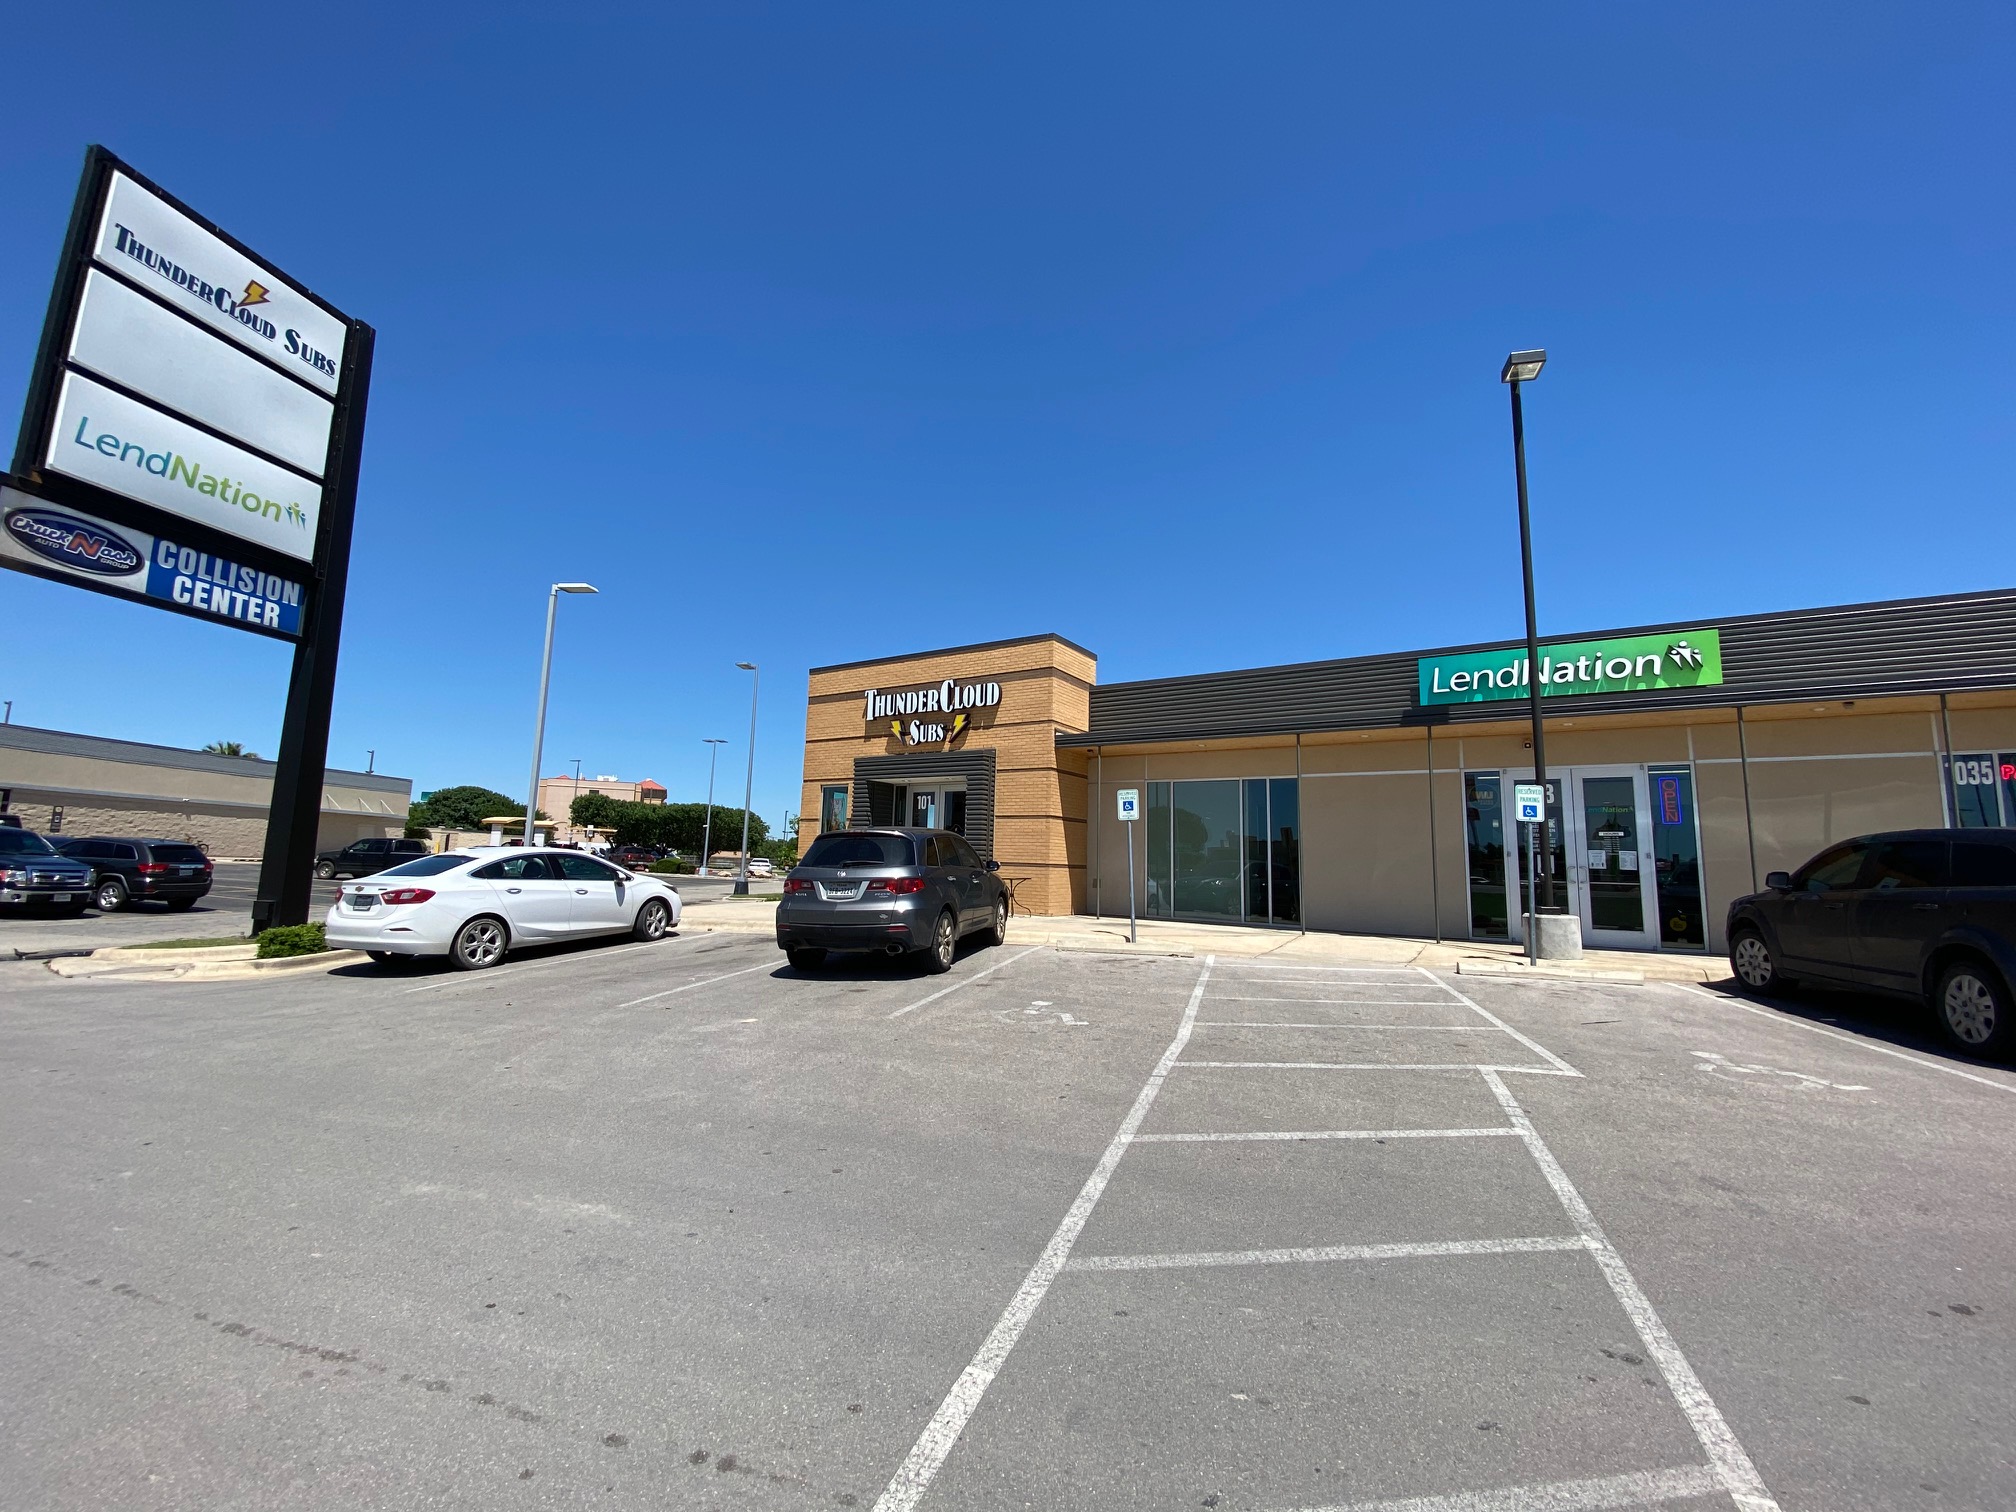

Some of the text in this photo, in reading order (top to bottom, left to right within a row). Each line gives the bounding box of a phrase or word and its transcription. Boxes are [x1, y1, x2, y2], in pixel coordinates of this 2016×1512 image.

[284, 329, 336, 376] SUBS
[74, 416, 282, 522] LendNation
[10, 516, 136, 565] Chuck Nash
[34, 538, 60, 549] AUTO
[100, 558, 129, 569] GROUP
[157, 540, 300, 606] COLLISION
[172, 575, 280, 628] CENTER
[1432, 651, 1662, 694] LendNation
[909, 719, 945, 746] SUBS
[1944, 761, 1994, 786] 035
[917, 795, 932, 810] 101
[1661, 779, 1679, 822] OPEN
